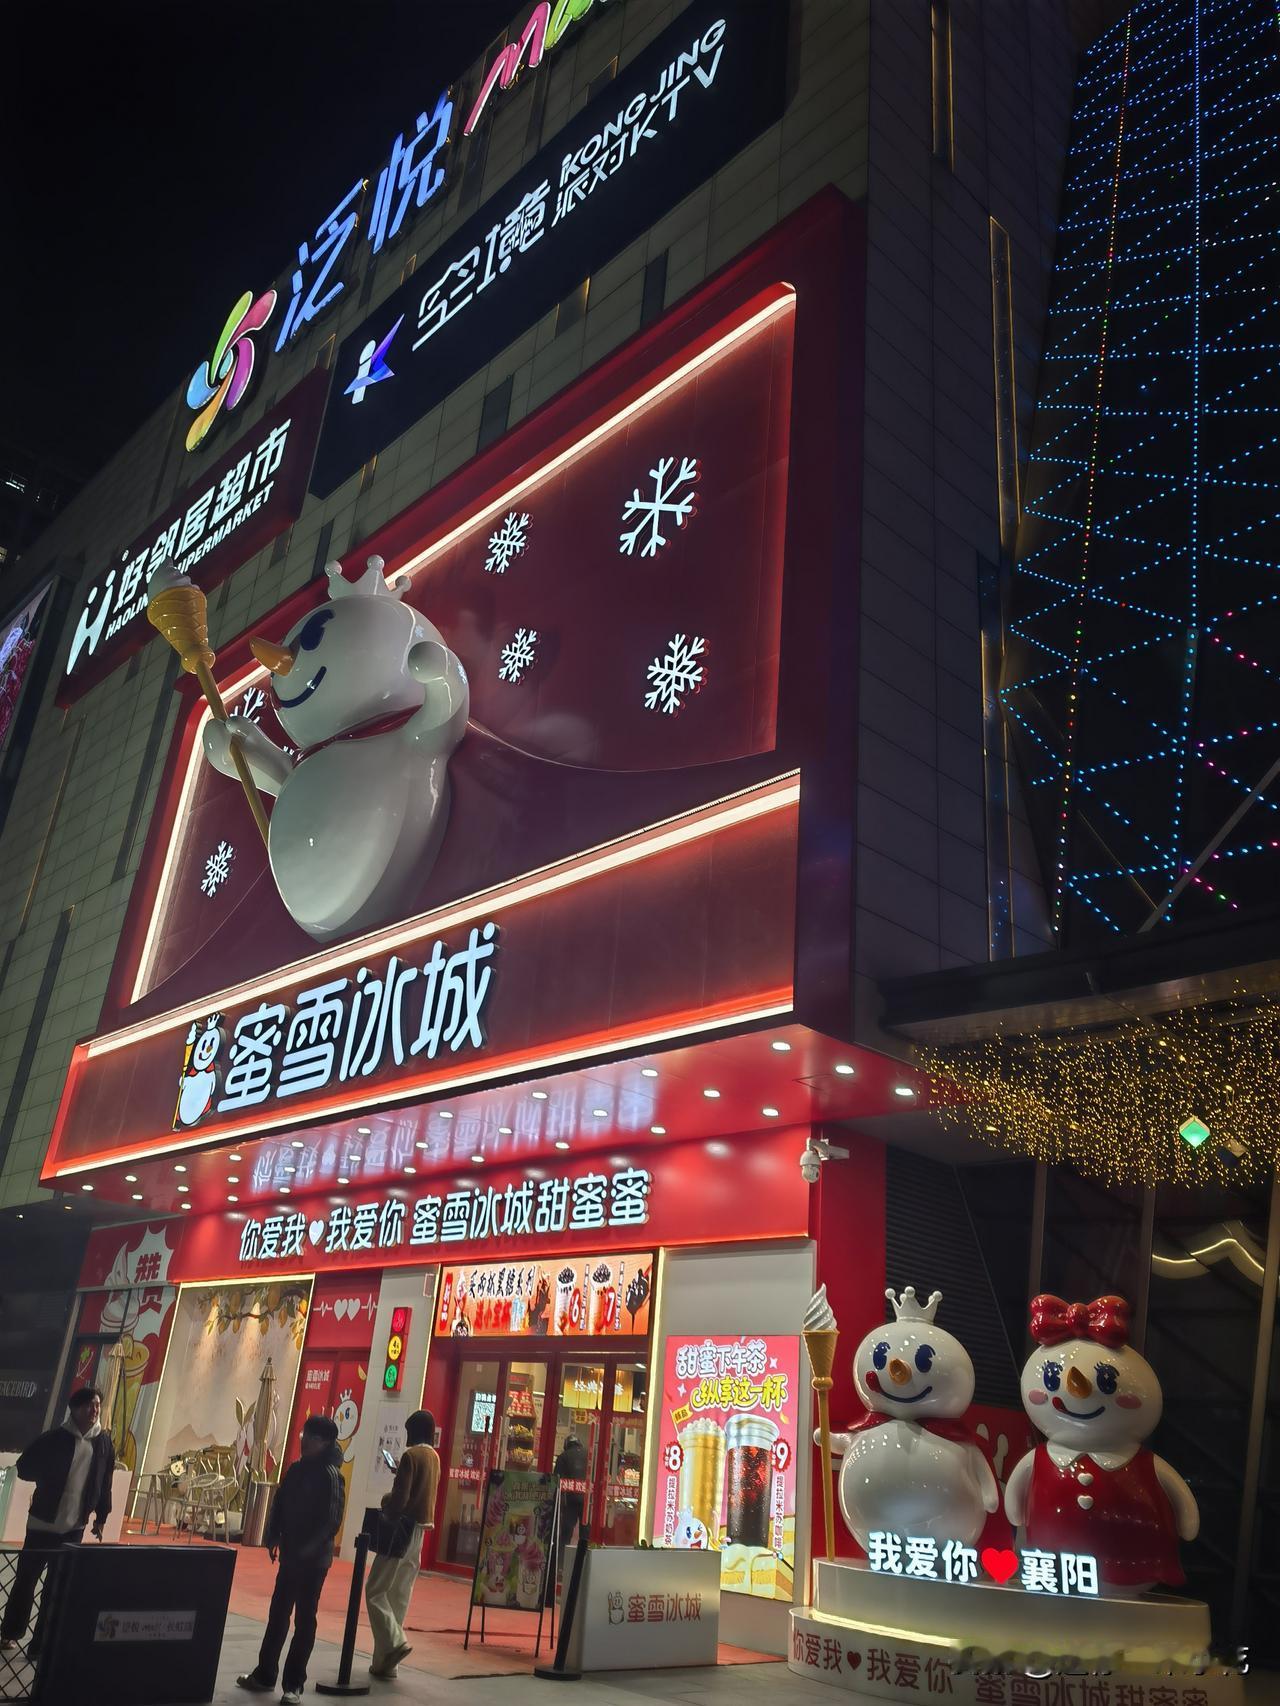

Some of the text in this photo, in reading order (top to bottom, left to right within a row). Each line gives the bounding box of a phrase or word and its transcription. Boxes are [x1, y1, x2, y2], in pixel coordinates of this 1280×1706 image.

[650, 19, 726, 103] JING
[552, 44, 725, 227] 派对KTV
[275, 88, 452, 352] 泛悦
[113, 418, 291, 612] 好邻居超市
[105, 481, 274, 641] HAOLIN UPERMARKET
[216, 922, 500, 1113] 蜜雪冰城
[239, 1167, 651, 1261] 你爱我 我爱你 蜜雪冰城甜蜜蜜
[677, 1340, 767, 1378] 甜蜜下午茶
[691, 1375, 788, 1410] 纵享这一杯
[868, 1531, 1099, 1595] 我爱你 襄阳
[627, 1593, 702, 1623] 蜜雪冰城
[793, 1628, 842, 1674] 你爱我
[867, 1648, 954, 1695] 我爱你
